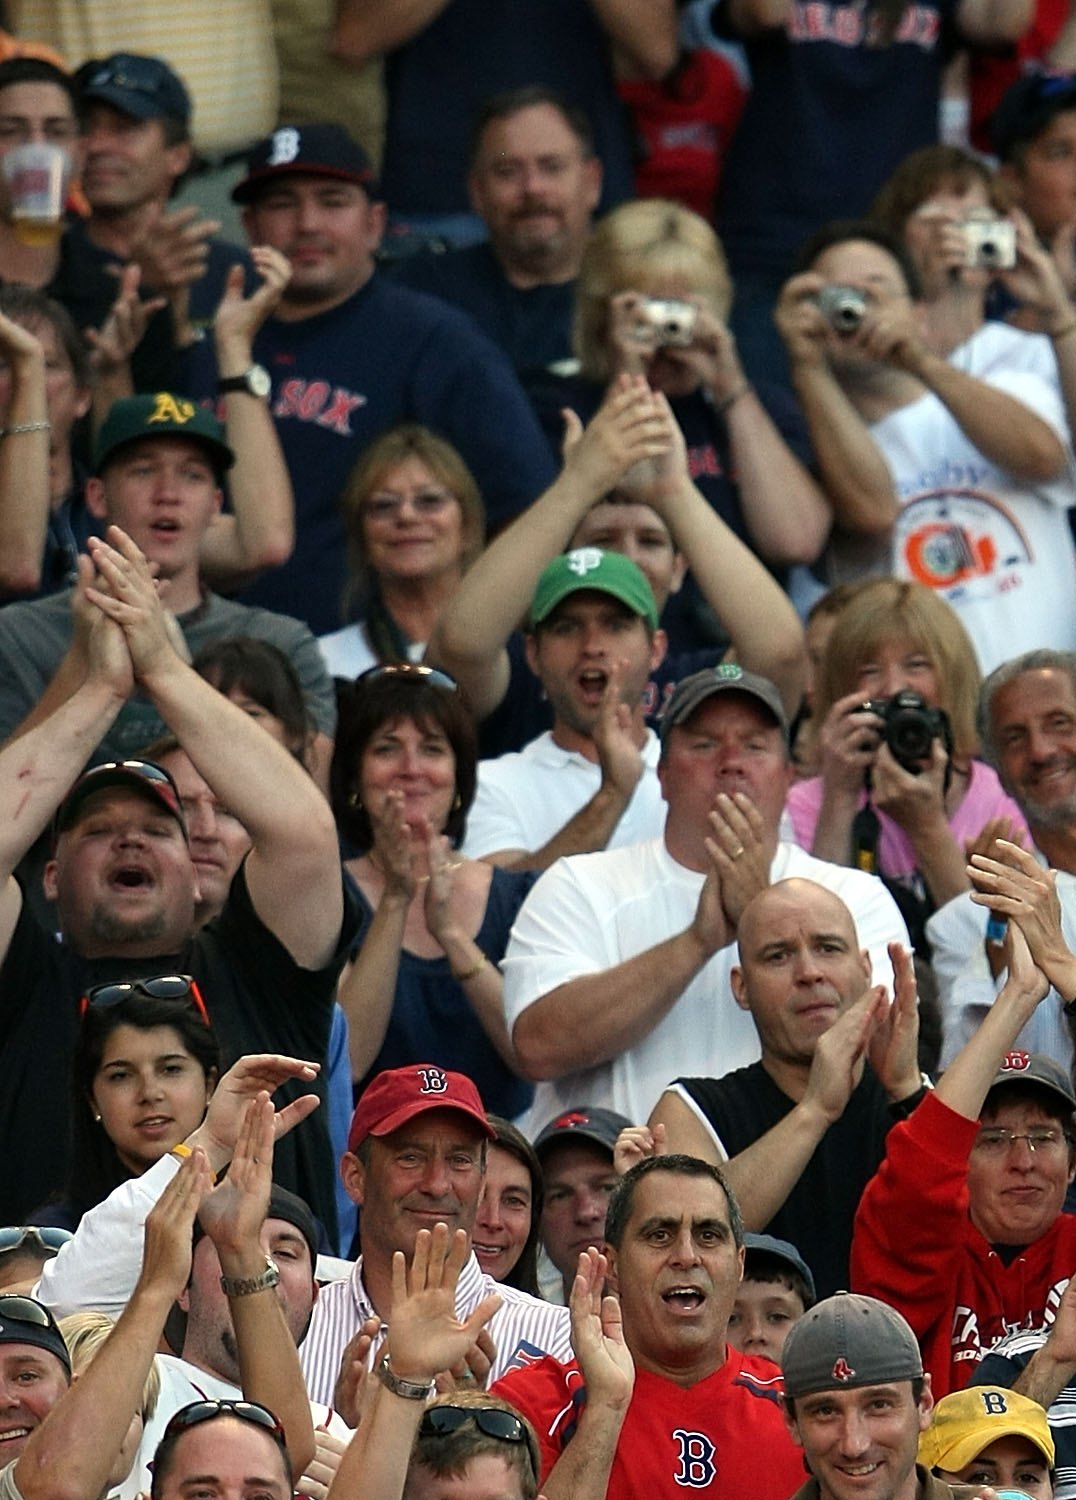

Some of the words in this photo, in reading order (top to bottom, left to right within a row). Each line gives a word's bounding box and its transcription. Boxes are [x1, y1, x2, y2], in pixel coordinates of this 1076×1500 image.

[266, 127, 300, 166] B
[274, 379, 369, 437] SOX
[417, 1068, 449, 1094] B
[982, 1391, 1008, 1416] B
[672, 1428, 718, 1489] B
